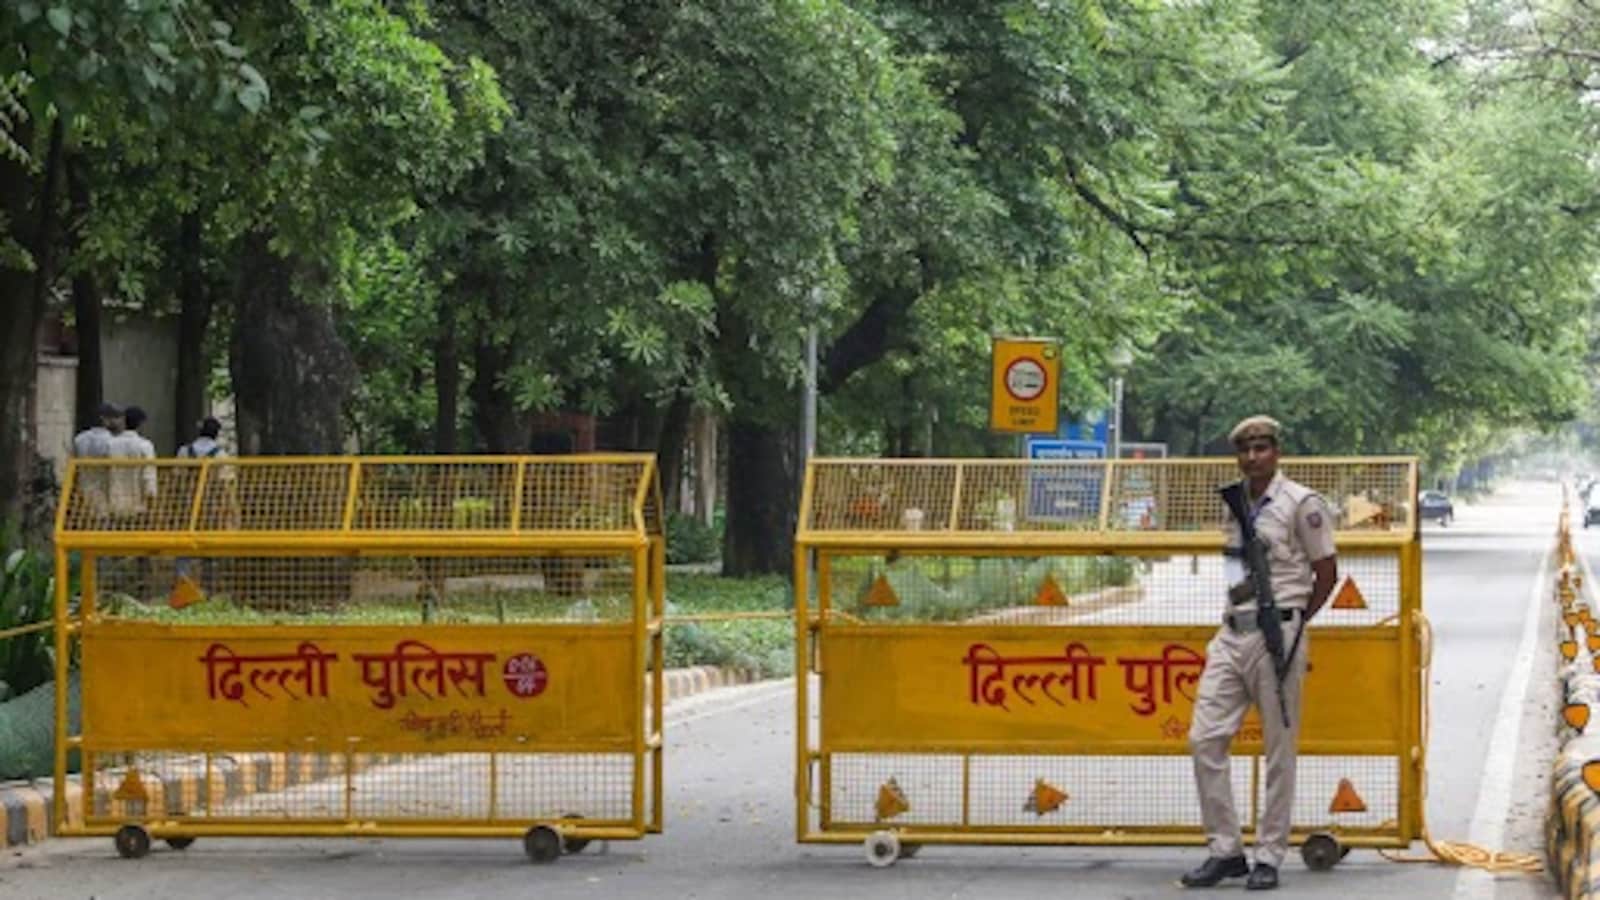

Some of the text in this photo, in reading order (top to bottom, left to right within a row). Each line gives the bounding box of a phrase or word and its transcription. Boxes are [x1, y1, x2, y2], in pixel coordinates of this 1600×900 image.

[198, 642, 339, 708] दिल्ली
[352, 640, 497, 710] पुलिस
[962, 643, 1206, 716] दिल्ली पुलि
